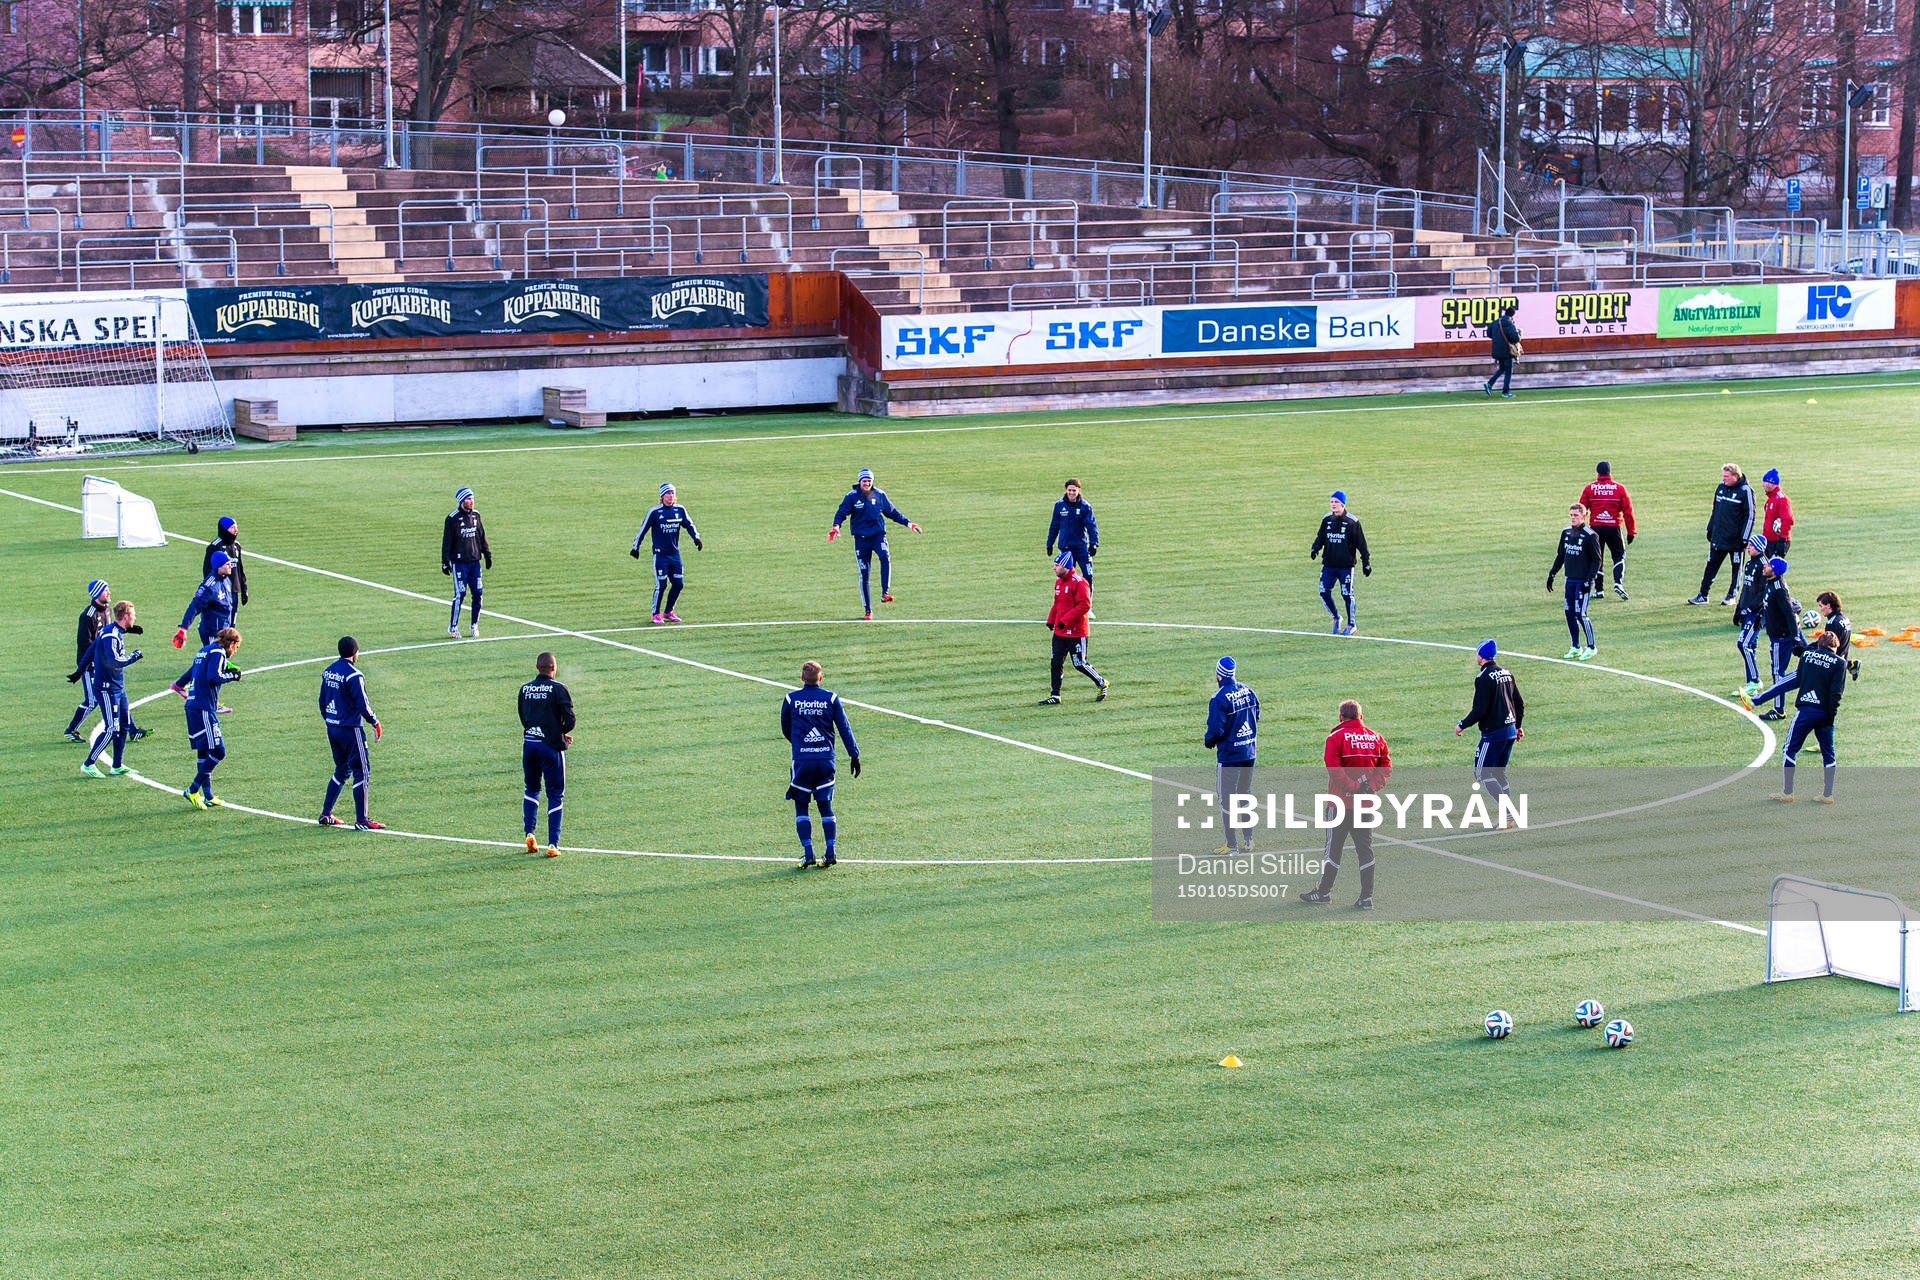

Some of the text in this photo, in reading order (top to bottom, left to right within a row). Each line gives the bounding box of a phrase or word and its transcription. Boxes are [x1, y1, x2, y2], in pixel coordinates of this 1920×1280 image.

[1790, 180, 1798, 193] P
[1860, 178, 1868, 191] P
[525, 283, 579, 292] PREMIUM CIDER
[672, 279, 725, 288] PREMIUM CIDER
[238, 290, 296, 300] PREMIUM CIDER
[372, 287, 428, 296] PREMIUM CIDER
[504, 291, 600, 324] KOPPARBERG
[651, 287, 745, 320] KOPPARBERG
[1556, 292, 1631, 324] SPORT
[1807, 284, 1852, 320] HTC
[216, 299, 319, 333] KOPPARBERG
[351, 295, 451, 328] KOPPARBERG
[1046, 319, 1143, 350] SKF
[1198, 314, 1400, 344] Danske Bank
[1559, 324, 1628, 335] BLADET
[896, 325, 995, 356] SKF
[1803, 651, 1838, 664] Prioritet
[522, 684, 553, 693] Prioritet
[525, 691, 547, 699] Finans
[795, 700, 827, 708] Prioritet
